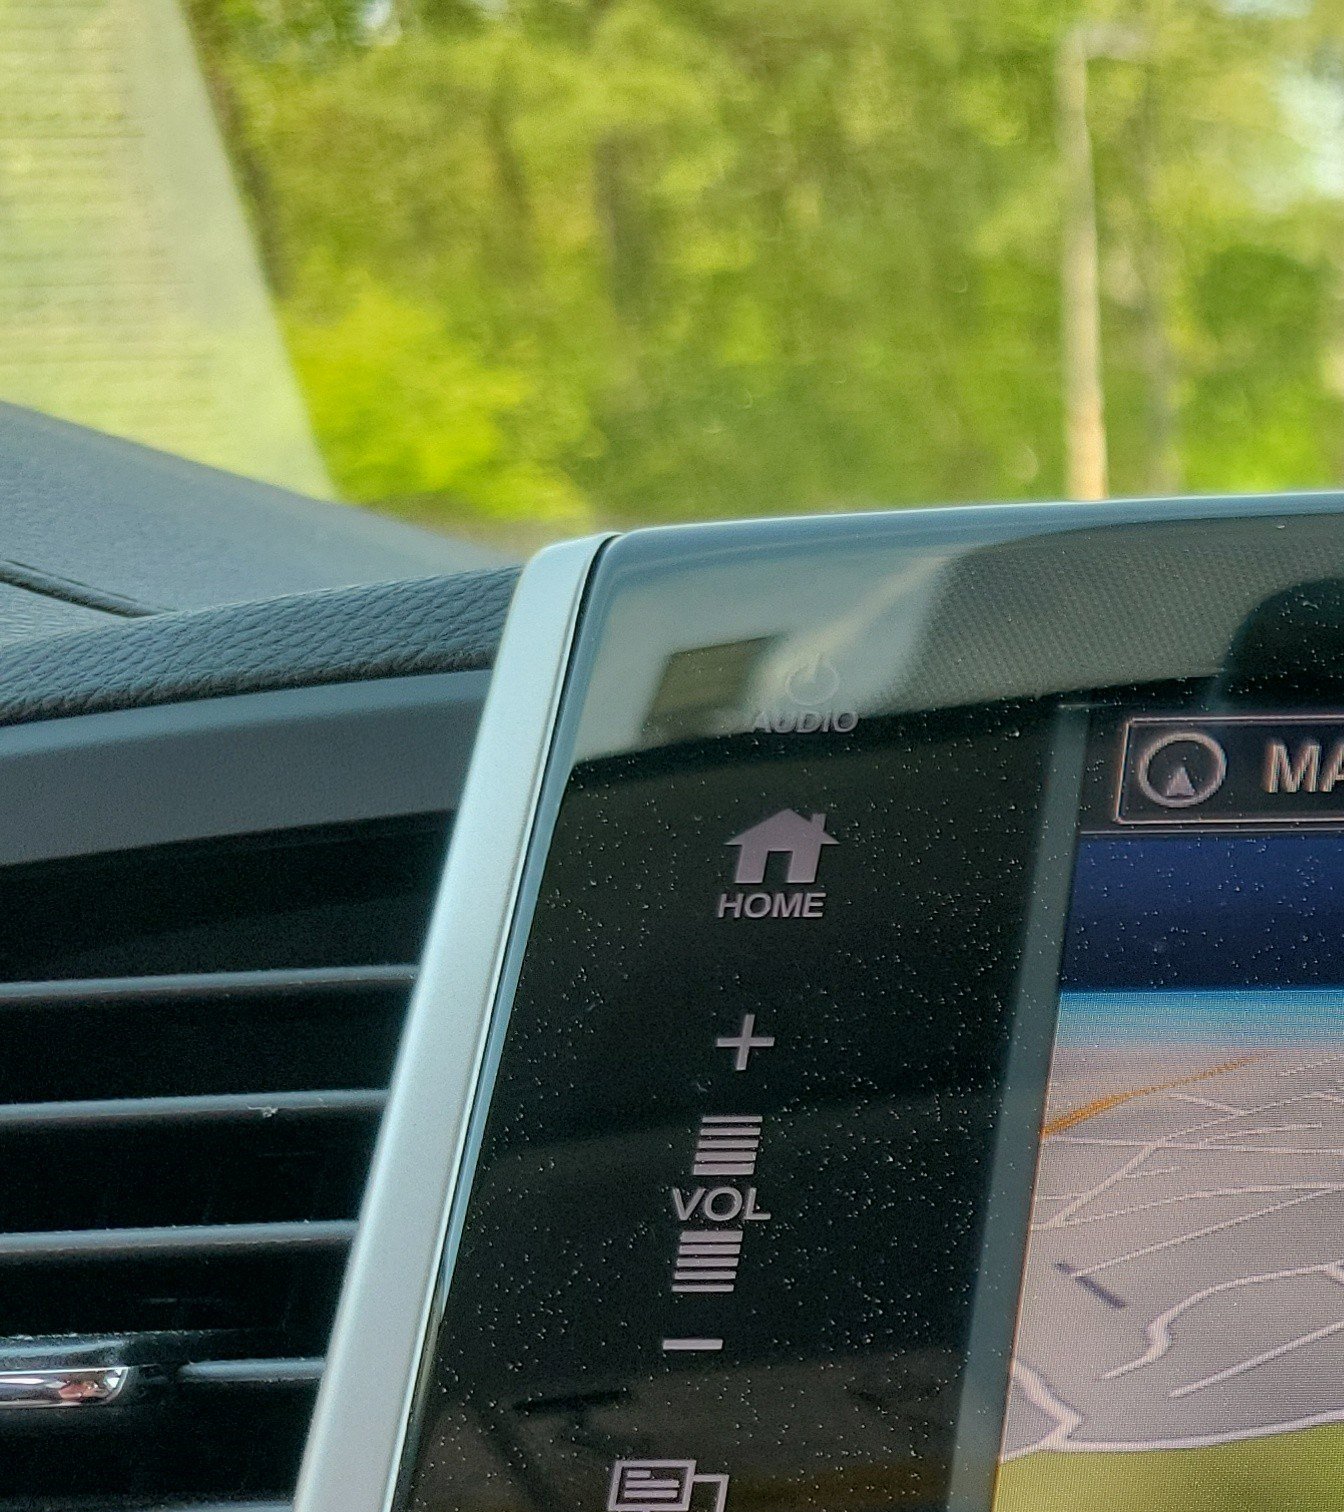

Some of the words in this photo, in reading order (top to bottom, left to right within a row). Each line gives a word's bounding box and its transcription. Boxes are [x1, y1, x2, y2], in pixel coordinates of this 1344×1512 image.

[749, 709, 859, 734] AUDIO
[717, 892, 828, 920] HOME
[671, 1187, 772, 1223] VOL
